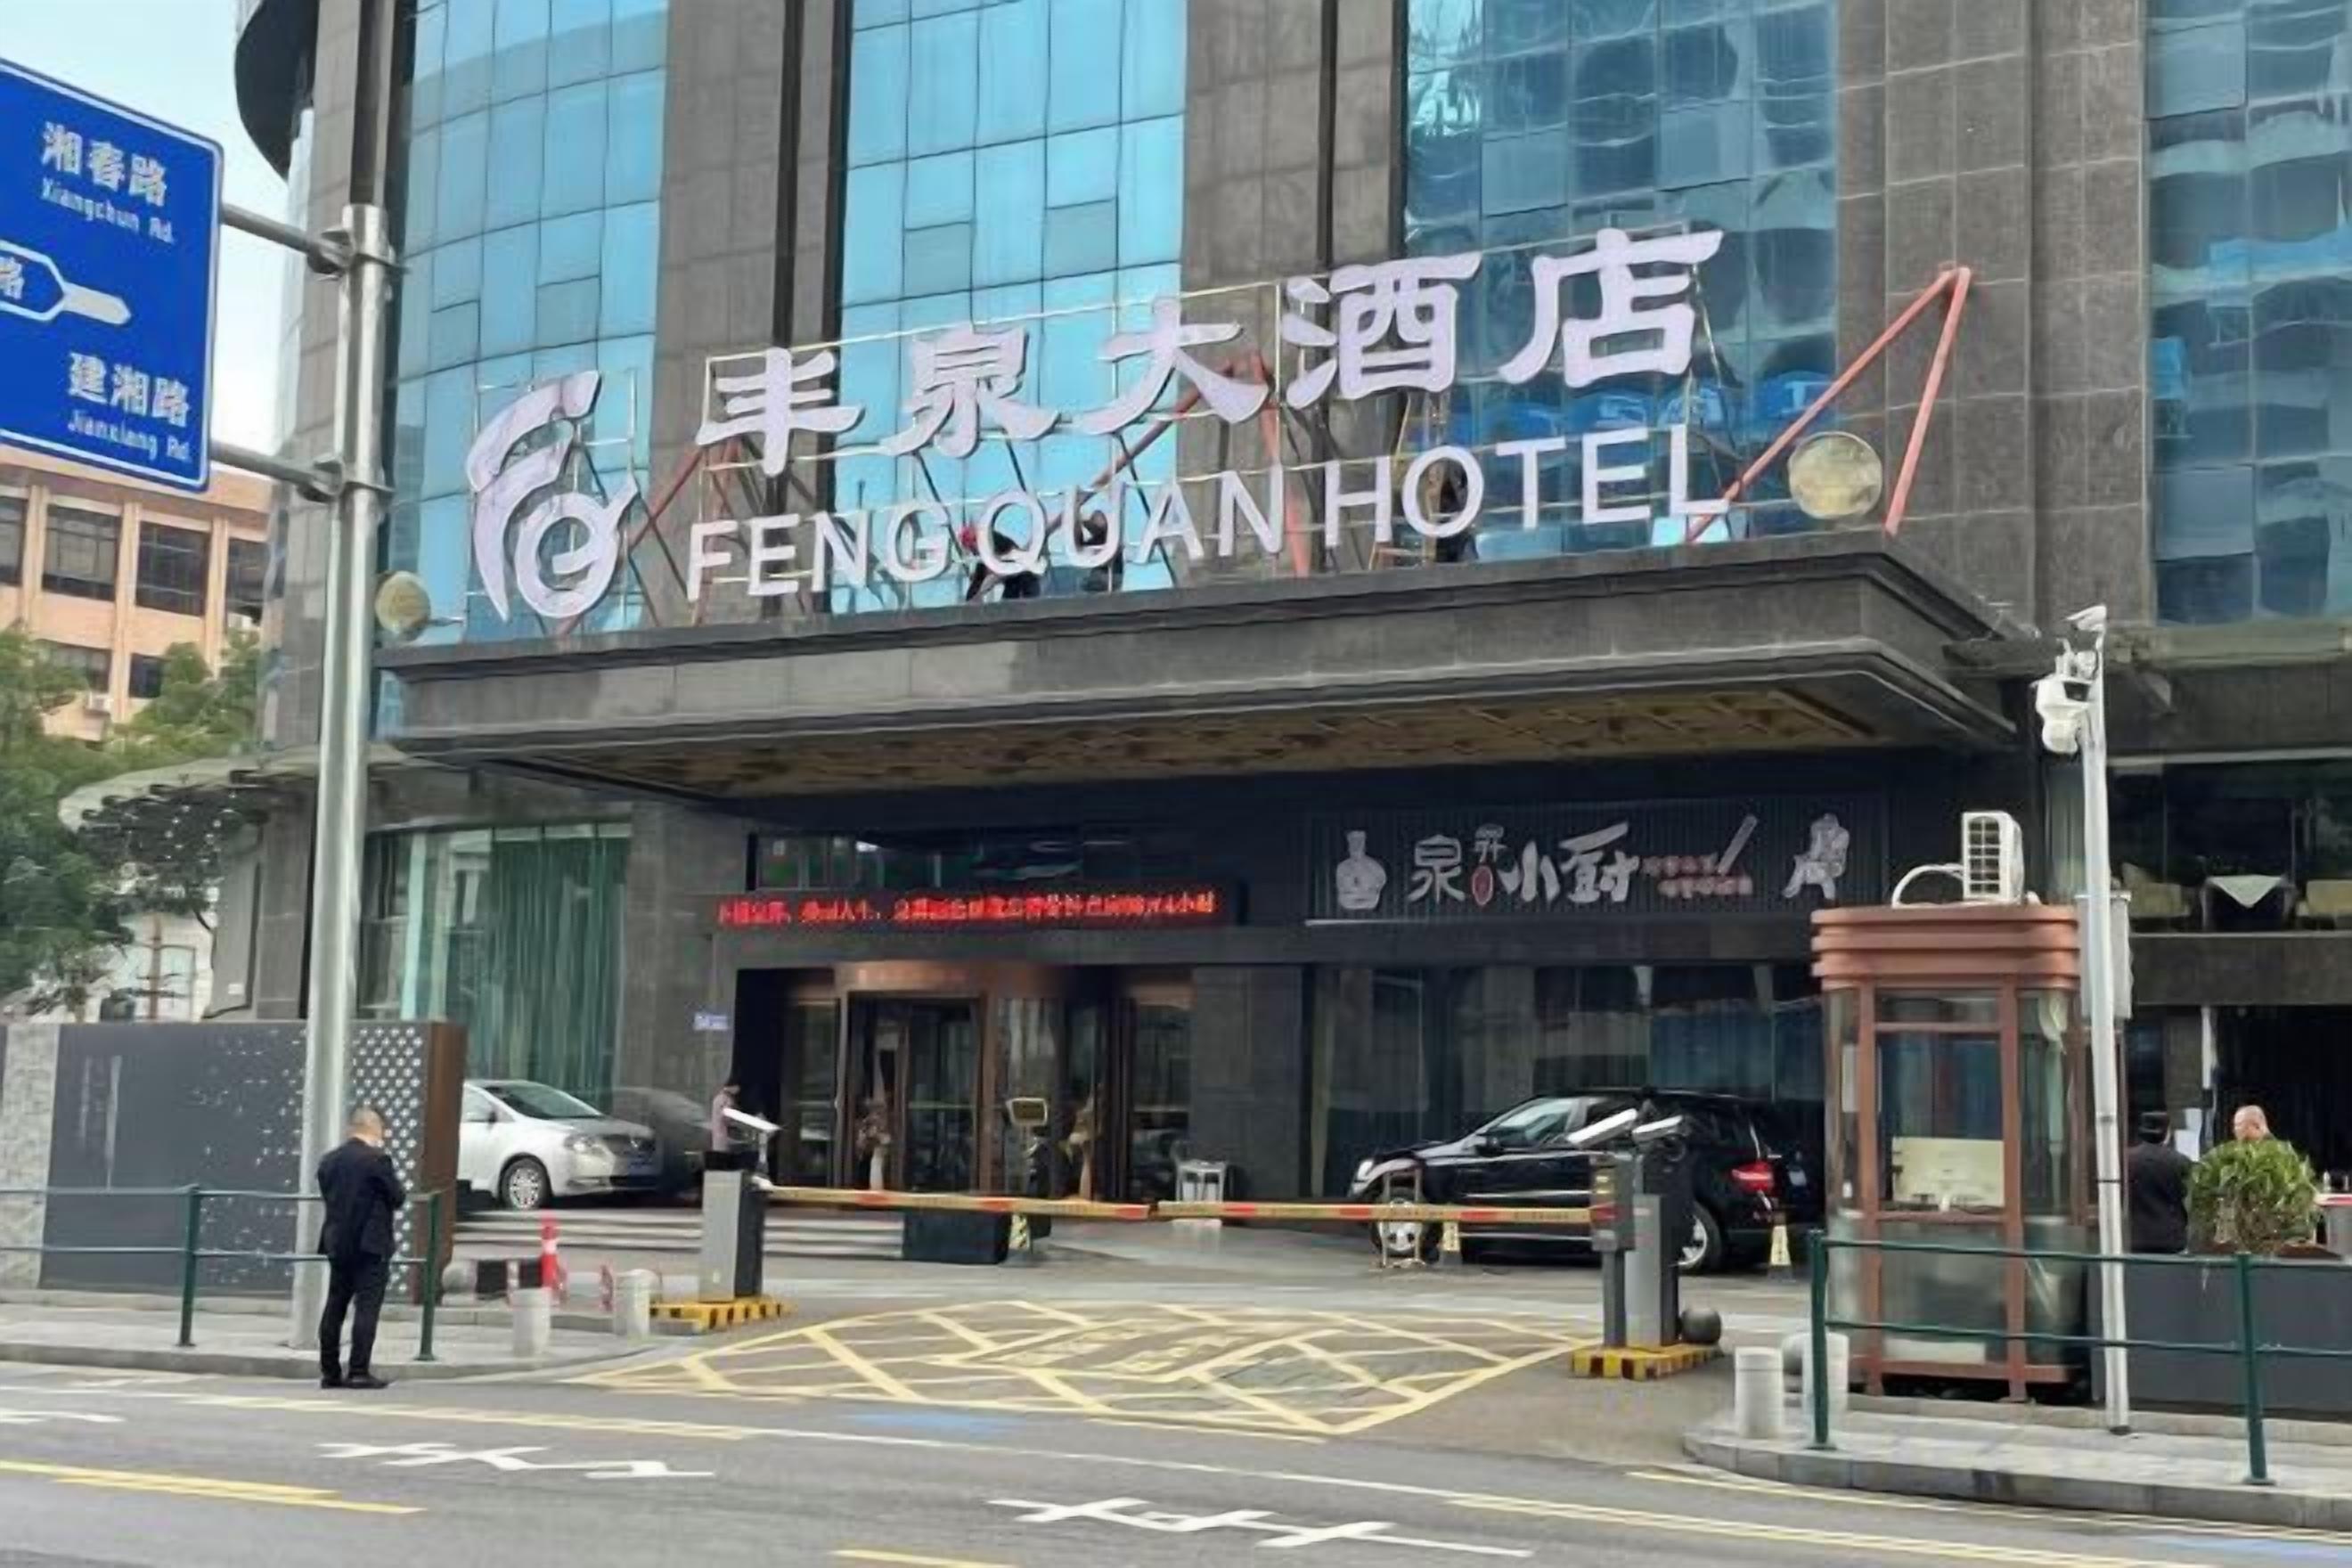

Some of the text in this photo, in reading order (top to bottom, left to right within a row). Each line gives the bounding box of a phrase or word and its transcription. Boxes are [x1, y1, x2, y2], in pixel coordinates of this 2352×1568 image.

[69, 352, 190, 428] 建湘路
[696, 228, 1724, 478] 丰泉大酒店
[1323, 423, 1730, 549] HOTEL
